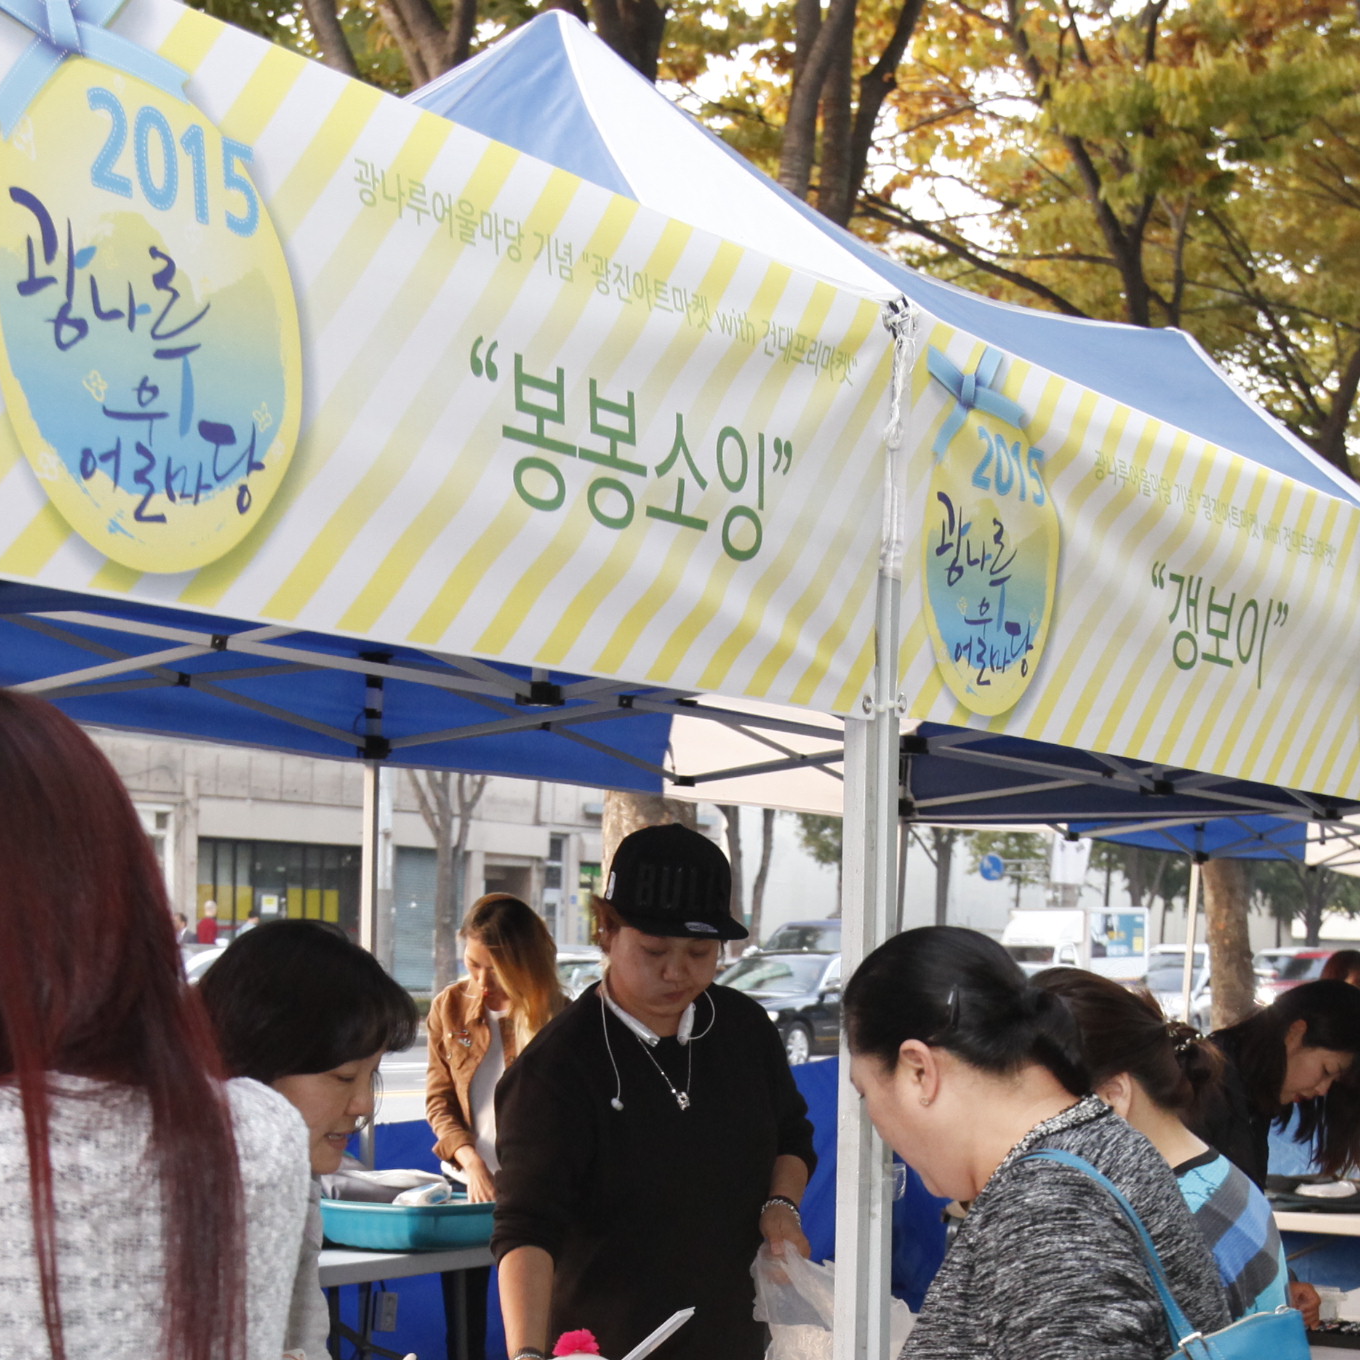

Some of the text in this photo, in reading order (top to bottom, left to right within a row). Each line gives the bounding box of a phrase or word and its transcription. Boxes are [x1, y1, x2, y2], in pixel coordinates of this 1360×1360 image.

[86, 86, 260, 238] 2015
[353, 157, 524, 264] 광나루어울마당
[532, 227, 575, 283] 기념
[714, 307, 756, 346] with
[469, 334, 793, 562] “봉봉소잉”
[971, 426, 1045, 507] 2015
